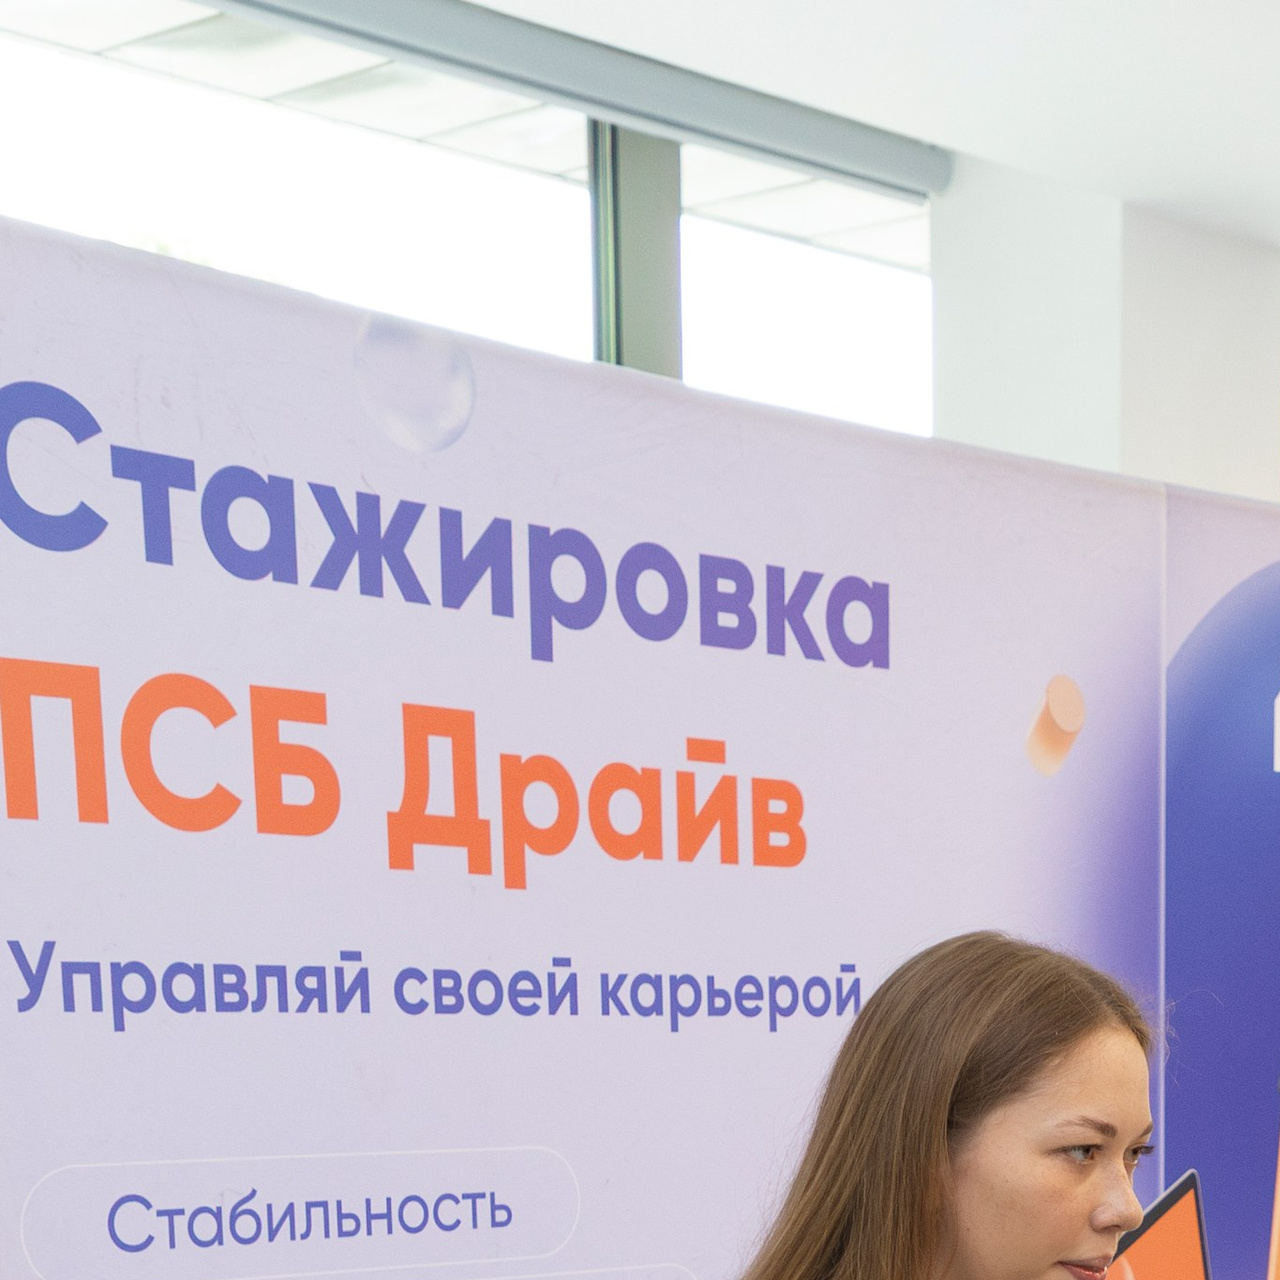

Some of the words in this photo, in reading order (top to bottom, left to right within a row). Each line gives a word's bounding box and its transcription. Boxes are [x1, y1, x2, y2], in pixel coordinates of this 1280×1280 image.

[0, 381, 891, 669] Стажировка
[0, 657, 342, 837] ПСБ
[387, 703, 808, 891] Драйв
[6, 940, 371, 1033] Управляй
[393, 957, 581, 1017] своей
[600, 964, 863, 1033] карьерой
[105, 1188, 514, 1254] Стабильность
